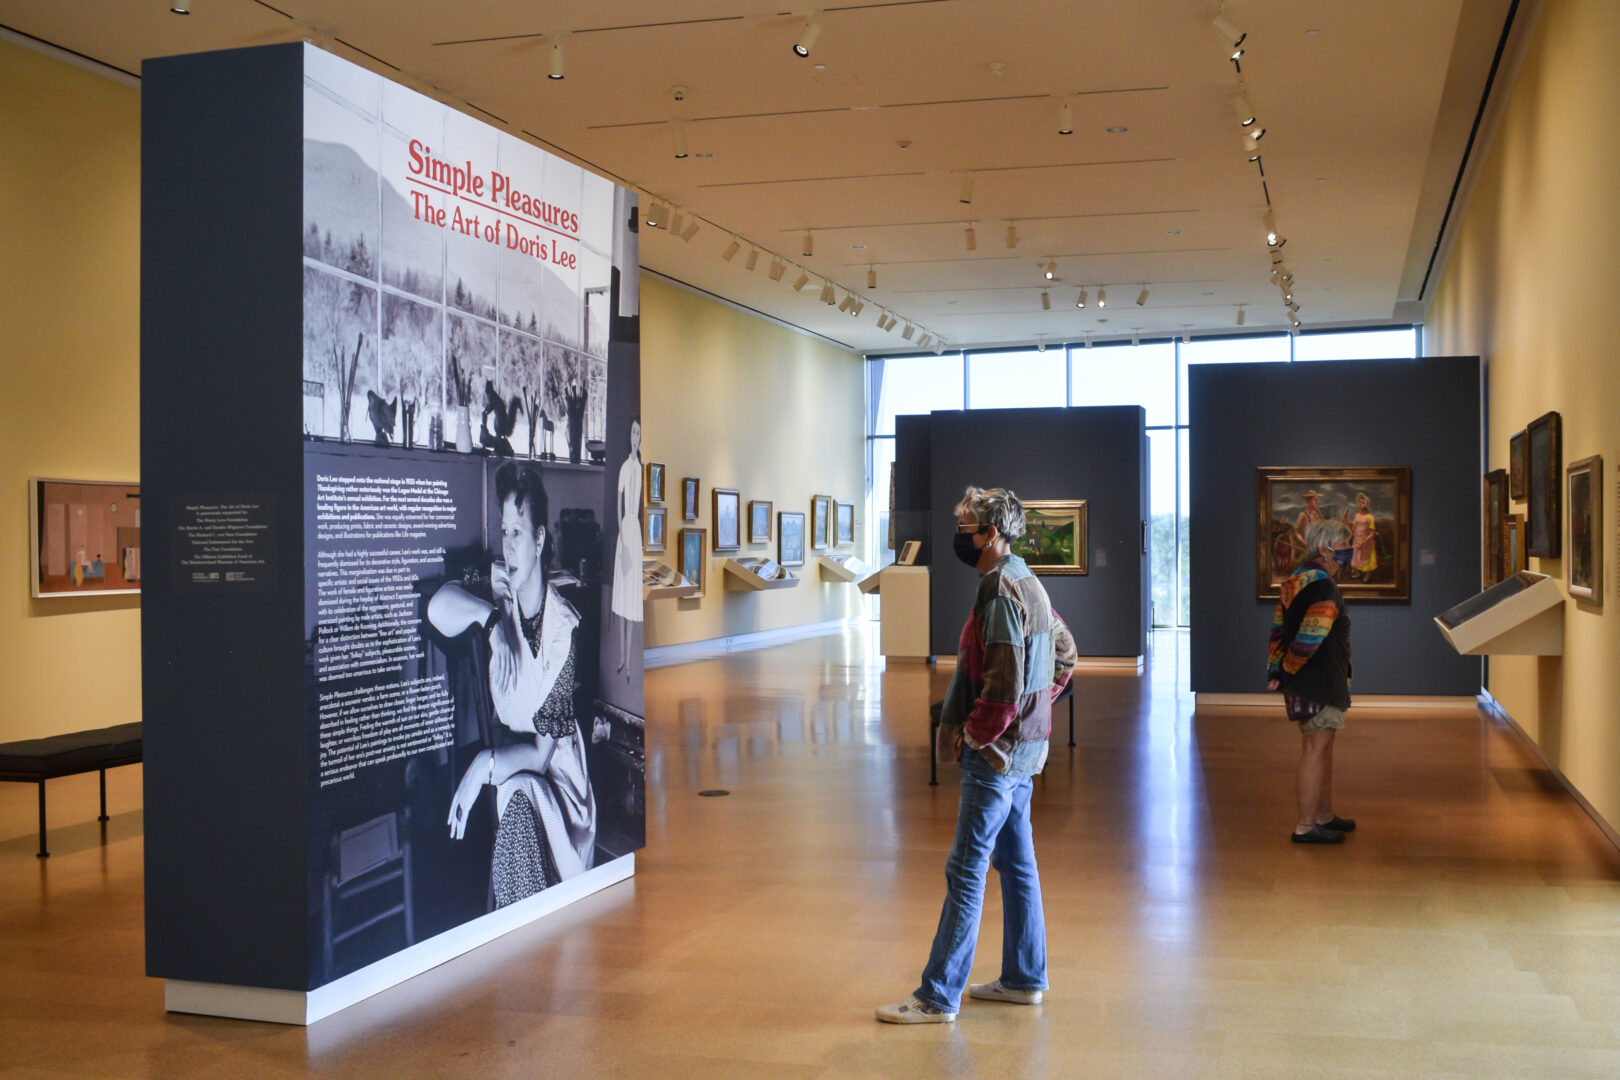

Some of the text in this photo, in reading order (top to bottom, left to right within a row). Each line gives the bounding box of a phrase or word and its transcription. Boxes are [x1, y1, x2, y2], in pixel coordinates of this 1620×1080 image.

[408, 139, 578, 233] Simple Pleasures
[410, 190, 577, 270] The Art of Doris Lee
